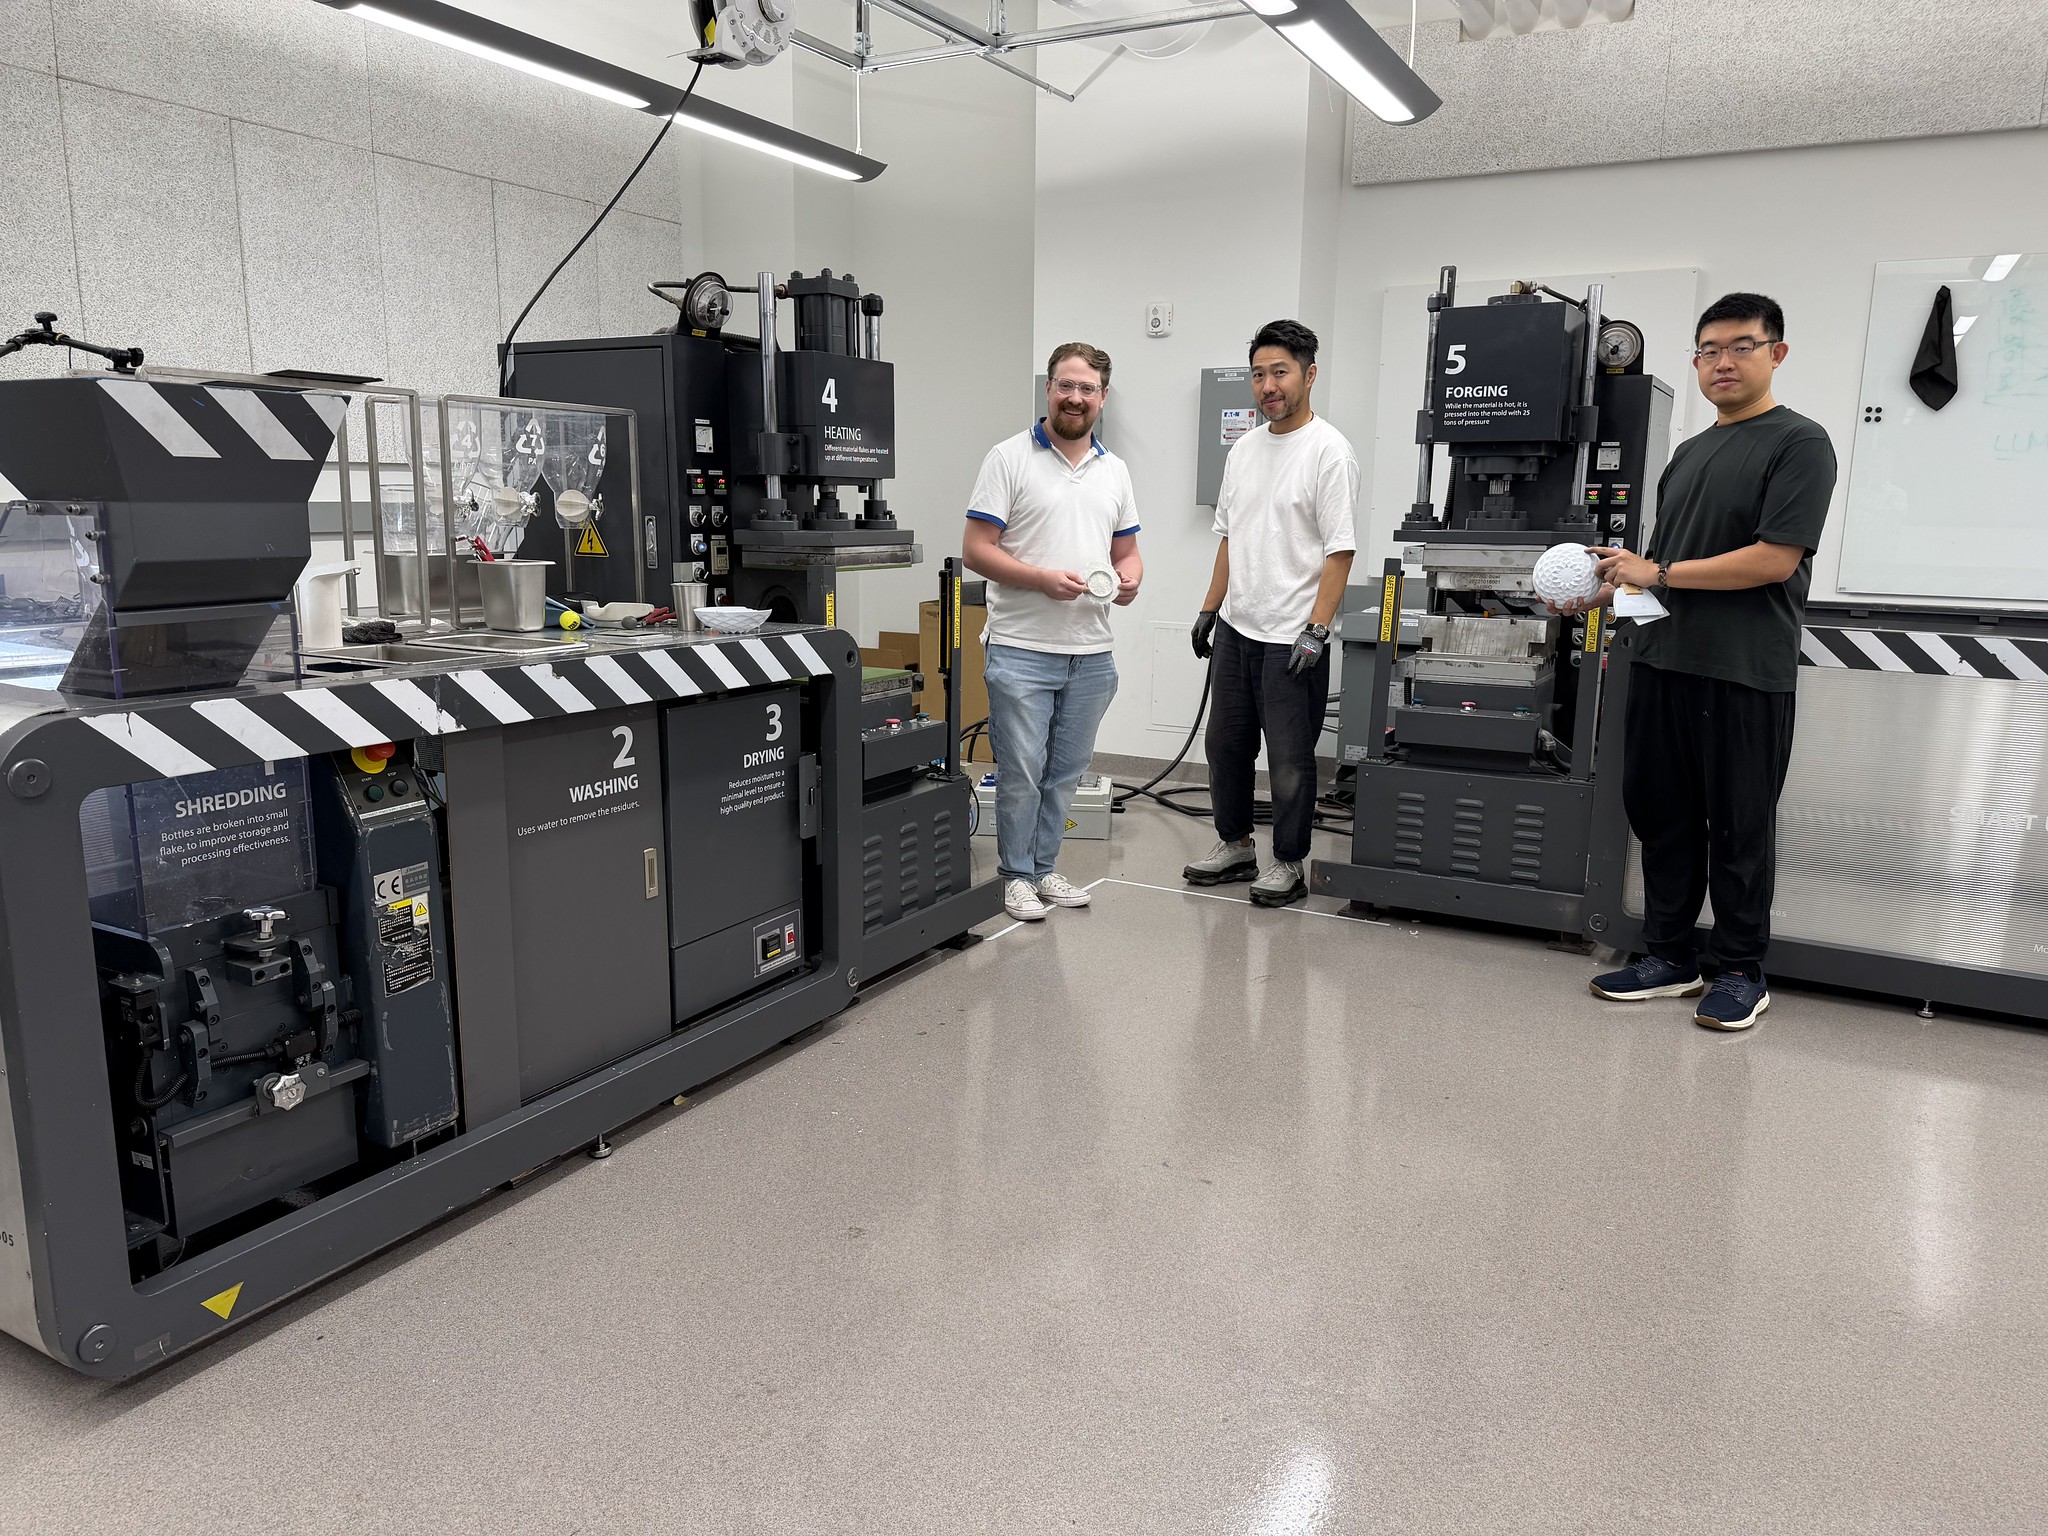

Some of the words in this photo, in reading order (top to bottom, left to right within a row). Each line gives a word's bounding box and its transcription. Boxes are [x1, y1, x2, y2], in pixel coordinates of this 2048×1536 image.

[1445, 344, 1466, 375] 5
[822, 378, 838, 413] 4
[1445, 385, 1508, 398] FORGING
[461, 433, 472, 448] 4
[529, 434, 537, 447] 7
[825, 425, 862, 441] HEATING
[600, 444, 606, 457] 6
[825, 444, 842, 452] Different
[842, 445, 858, 453] material
[836, 454, 853, 462] different
[1386, 575, 1395, 597] SAFETY
[1384, 598, 1393, 615] LIGHT
[1382, 616, 1391, 640] CURTAIN
[1587, 625, 1597, 651] CURTAIN
[766, 703, 783, 741] 3
[611, 725, 635, 769] 2
[743, 746, 785, 769] DRYING
[568, 773, 639, 803] WASHING
[728, 777, 751, 789] Reduces
[752, 772, 775, 783] moisture
[175, 782, 287, 819] SHREDDING
[721, 792, 744, 803] minimal
[744, 786, 757, 797] level
[757, 784, 764, 793] to
[764, 782, 781, 791] ensure
[720, 804, 733, 816] high
[733, 799, 752, 812] quality
[752, 795, 763, 805] end
[161, 828, 195, 842] Bottles
[196, 824, 211, 835] are
[212, 818, 245, 832] broken
[247, 812, 264, 825] into
[265, 807, 289, 821] small
[517, 825, 536, 836] Uses
[537, 818, 559, 832] water
[560, 817, 568, 826] to
[569, 810, 597, 824] remove
[597, 807, 609, 817] the
[610, 800, 640, 814] residues.
[1949, 806, 2038, 831] SMART
[159, 844, 186, 856] flake,
[186, 840, 197, 850] to
[199, 833, 237, 850] improve
[238, 826, 271, 841] storage
[272, 820, 289, 833] and
[181, 848, 231, 867] processing
[232, 833, 291, 855] effectiveness.
